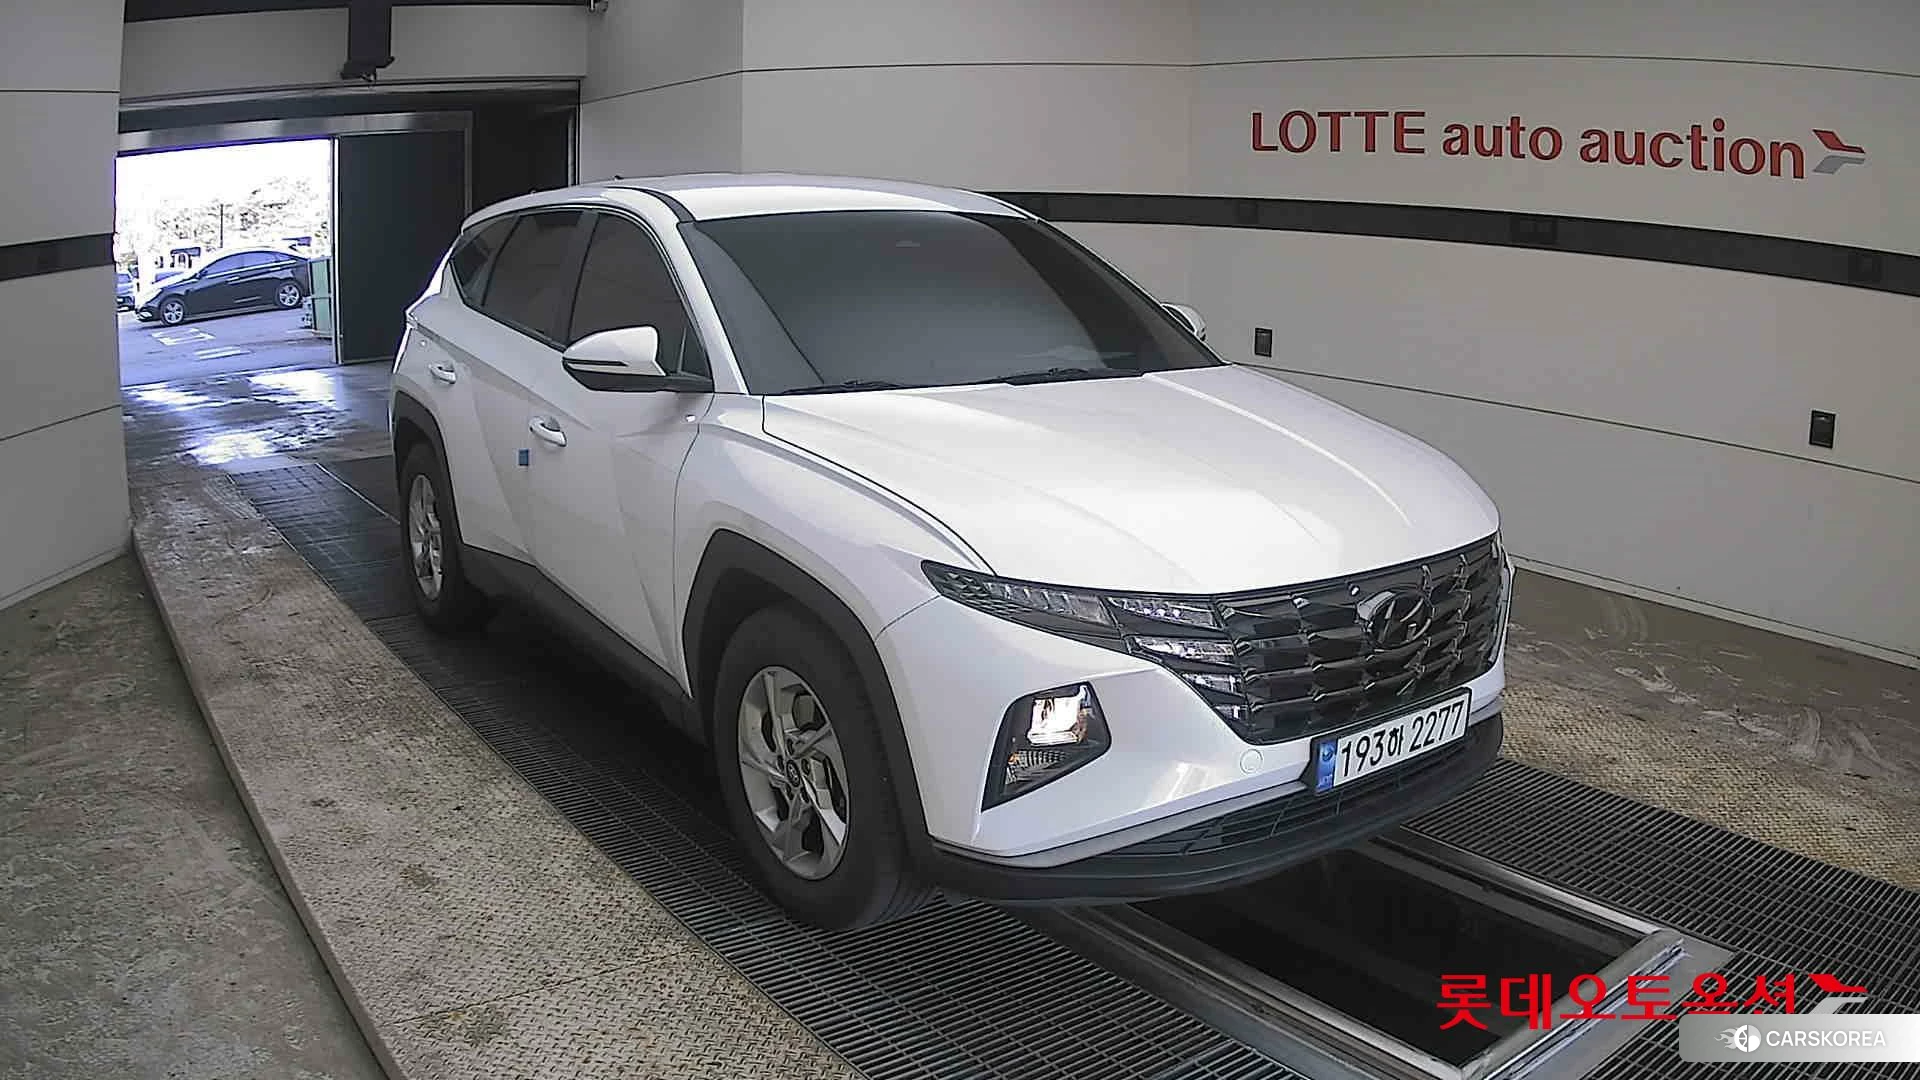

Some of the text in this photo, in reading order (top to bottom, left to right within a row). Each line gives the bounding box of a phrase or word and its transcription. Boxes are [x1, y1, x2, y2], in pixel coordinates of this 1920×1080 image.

[1251, 110, 1806, 179] LOTTE auto auction
[1341, 700, 1465, 777] 193하 2277
